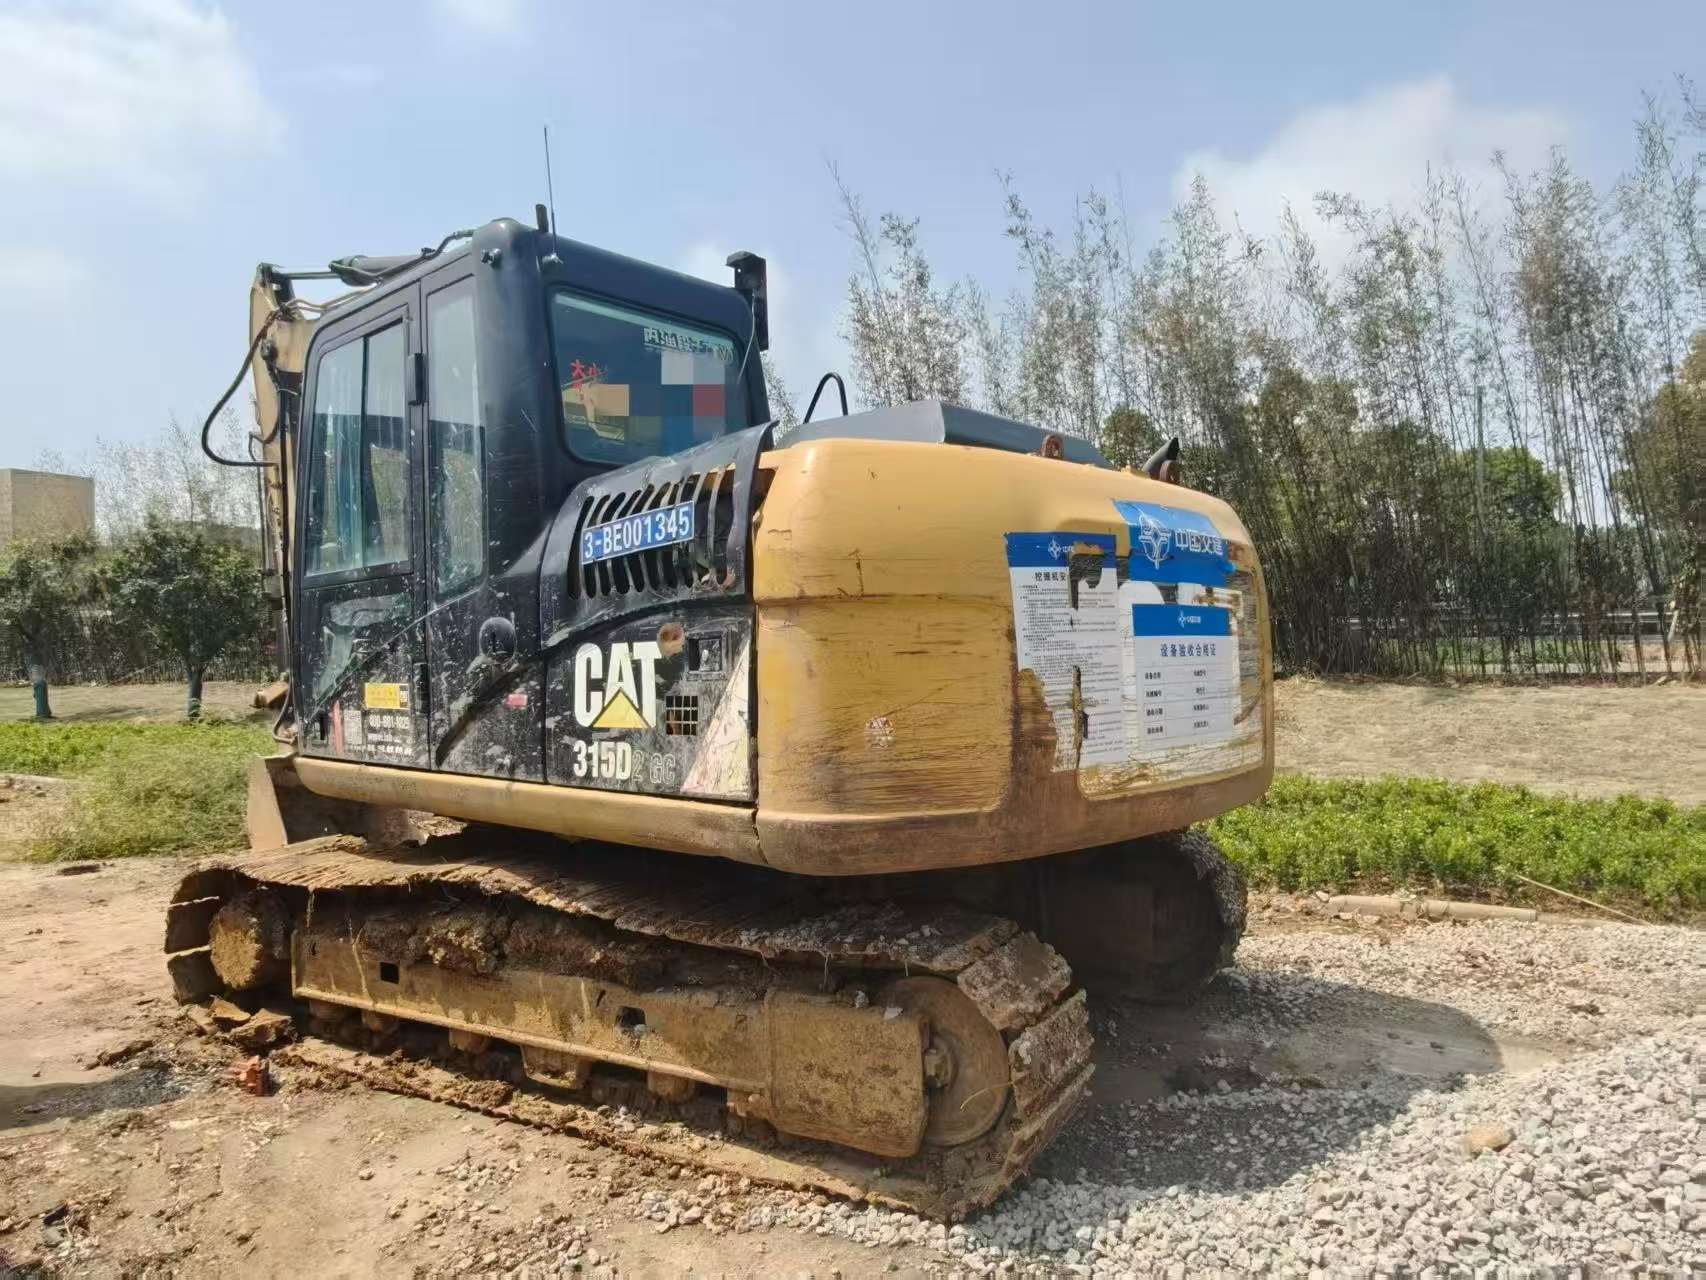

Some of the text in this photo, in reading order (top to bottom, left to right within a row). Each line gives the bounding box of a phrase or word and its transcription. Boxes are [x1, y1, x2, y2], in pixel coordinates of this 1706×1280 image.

[584, 507, 690, 559] 3-BE001345
[1175, 528, 1224, 556] 中国交建
[1160, 642, 1217, 658] 设备验收合格证
[574, 641, 663, 729] CAT
